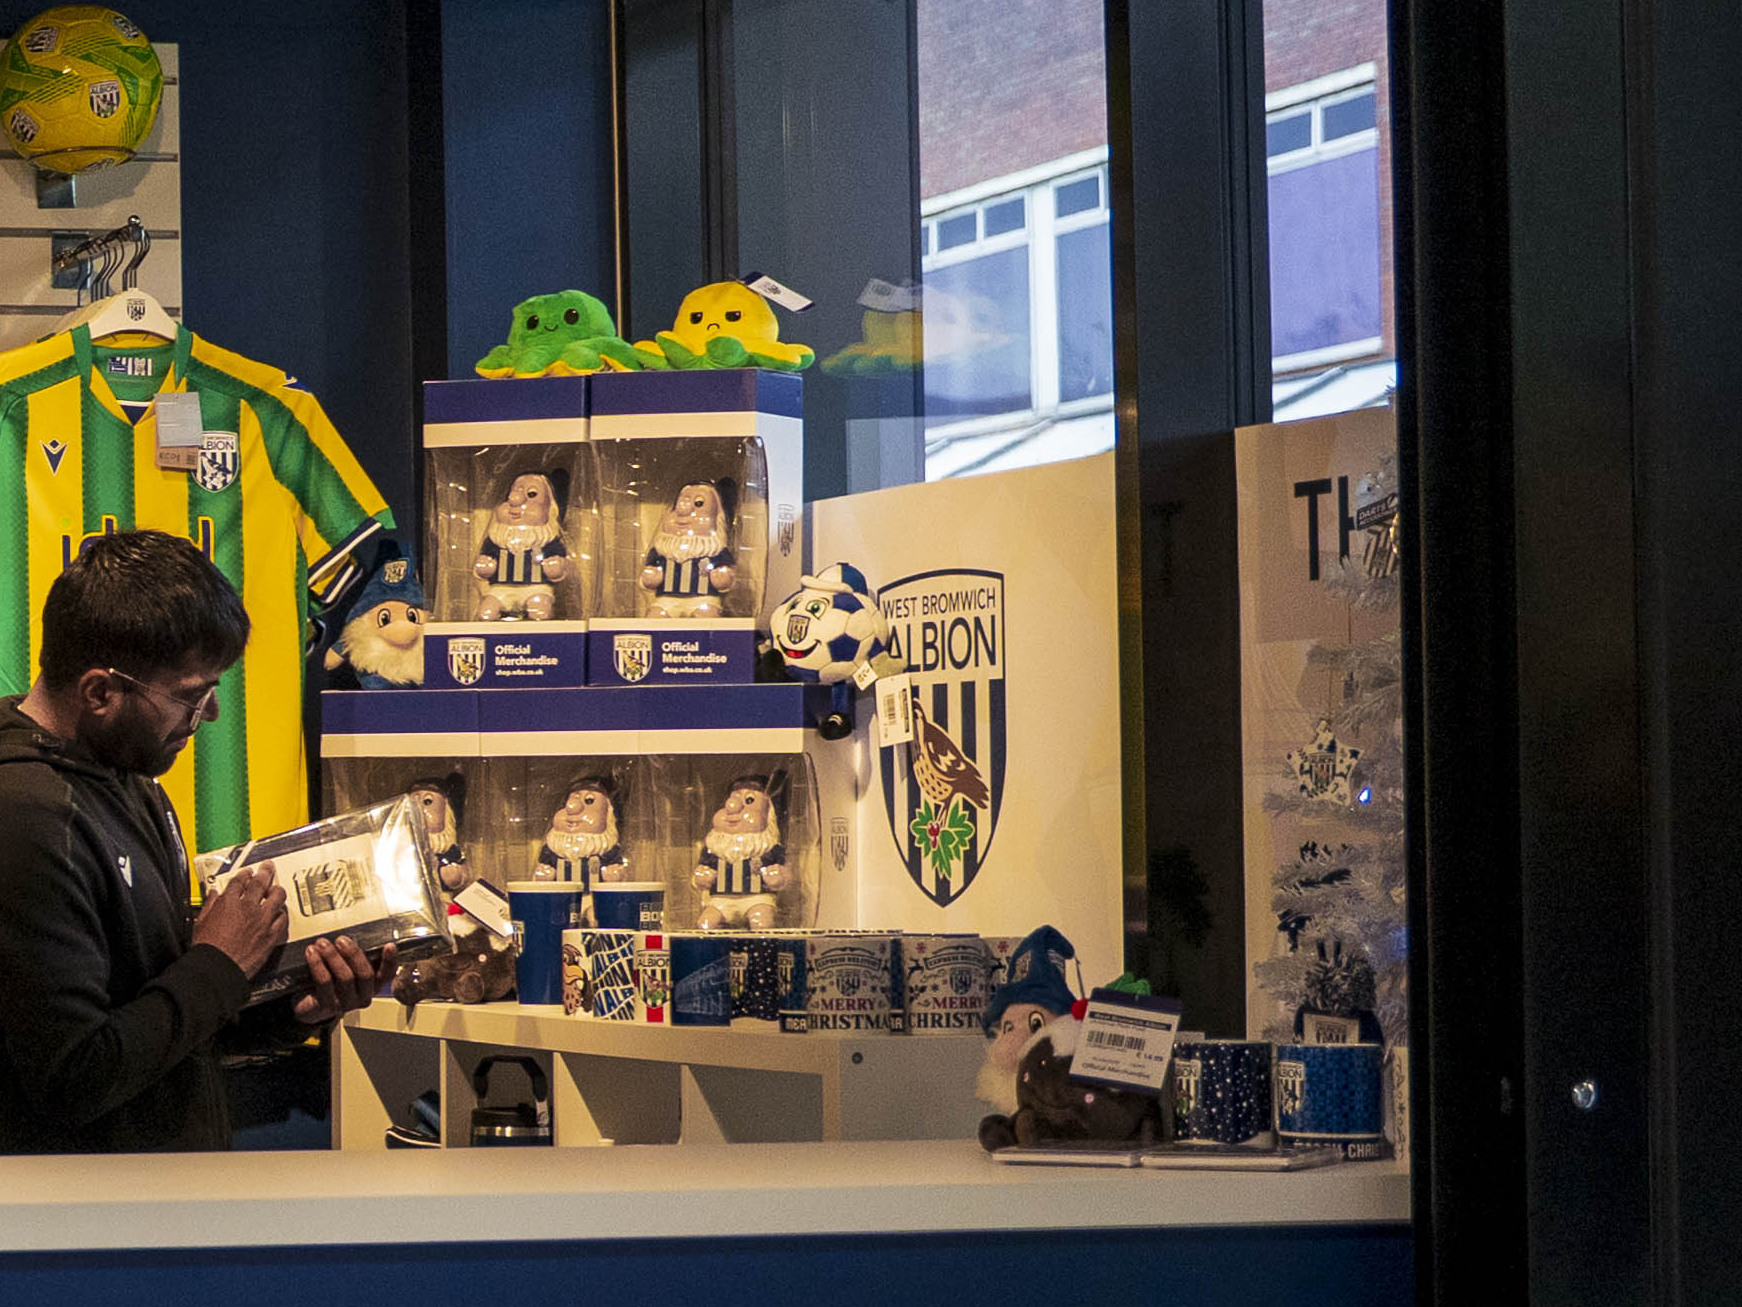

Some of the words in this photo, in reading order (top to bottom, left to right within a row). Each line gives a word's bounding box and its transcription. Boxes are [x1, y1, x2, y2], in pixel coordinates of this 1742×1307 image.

[882, 596, 920, 620] WEST
[922, 587, 996, 615] BROMWICH
[494, 643, 532, 655] Official
[662, 641, 701, 653] Official
[887, 614, 997, 674] ALBION
[494, 654, 560, 666] Merchandise
[662, 651, 729, 664] Merchandise
[818, 997, 876, 1012] MERRY
